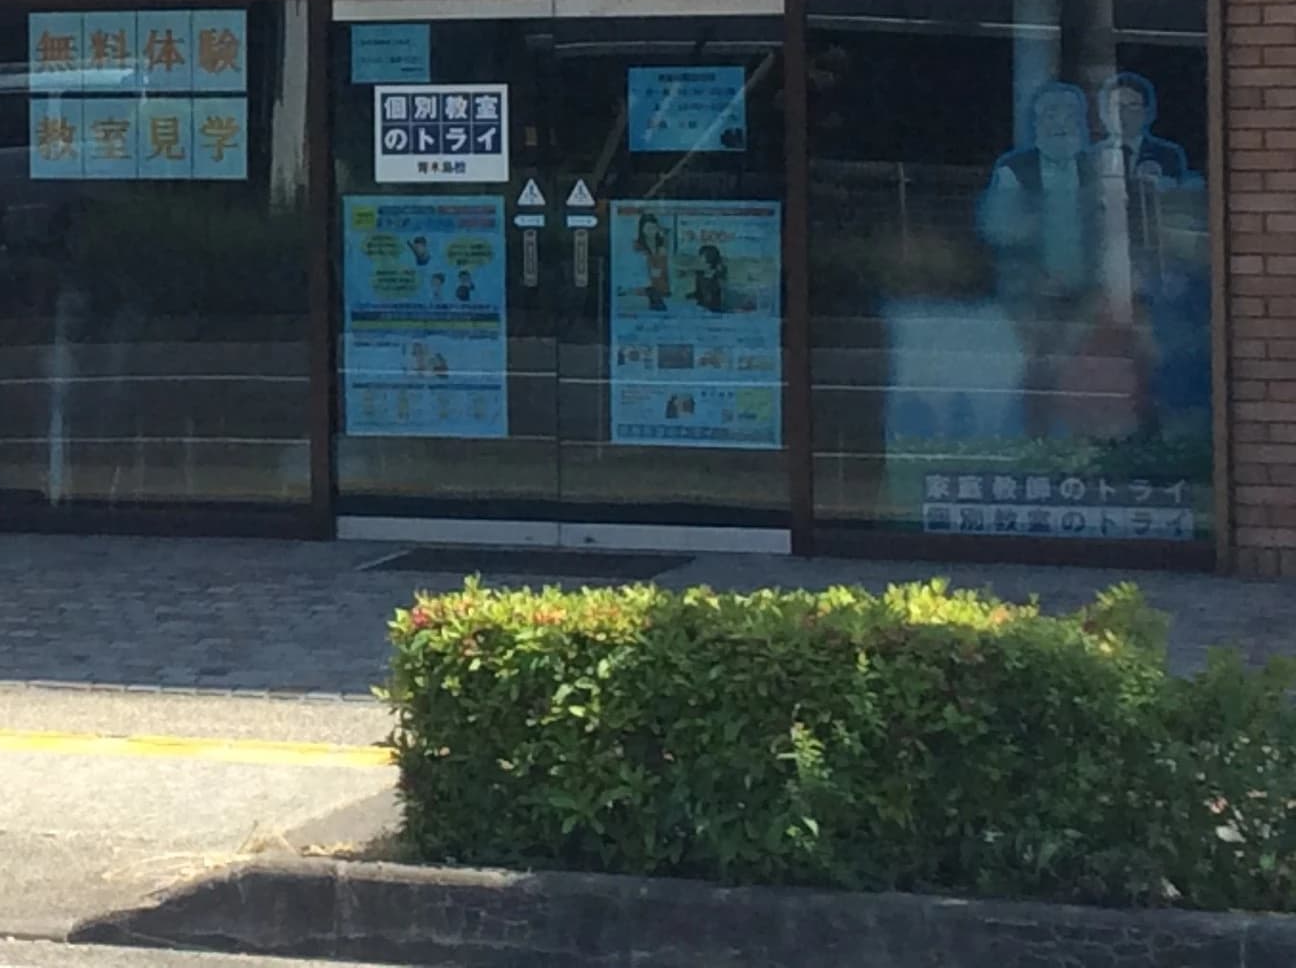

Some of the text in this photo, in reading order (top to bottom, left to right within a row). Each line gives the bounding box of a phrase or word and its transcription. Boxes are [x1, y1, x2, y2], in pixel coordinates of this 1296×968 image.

[36, 28, 241, 74] 無料体験
[384, 96, 499, 120] 個別教室
[37, 115, 241, 162] 教室見学
[384, 128, 497, 152] のトライ
